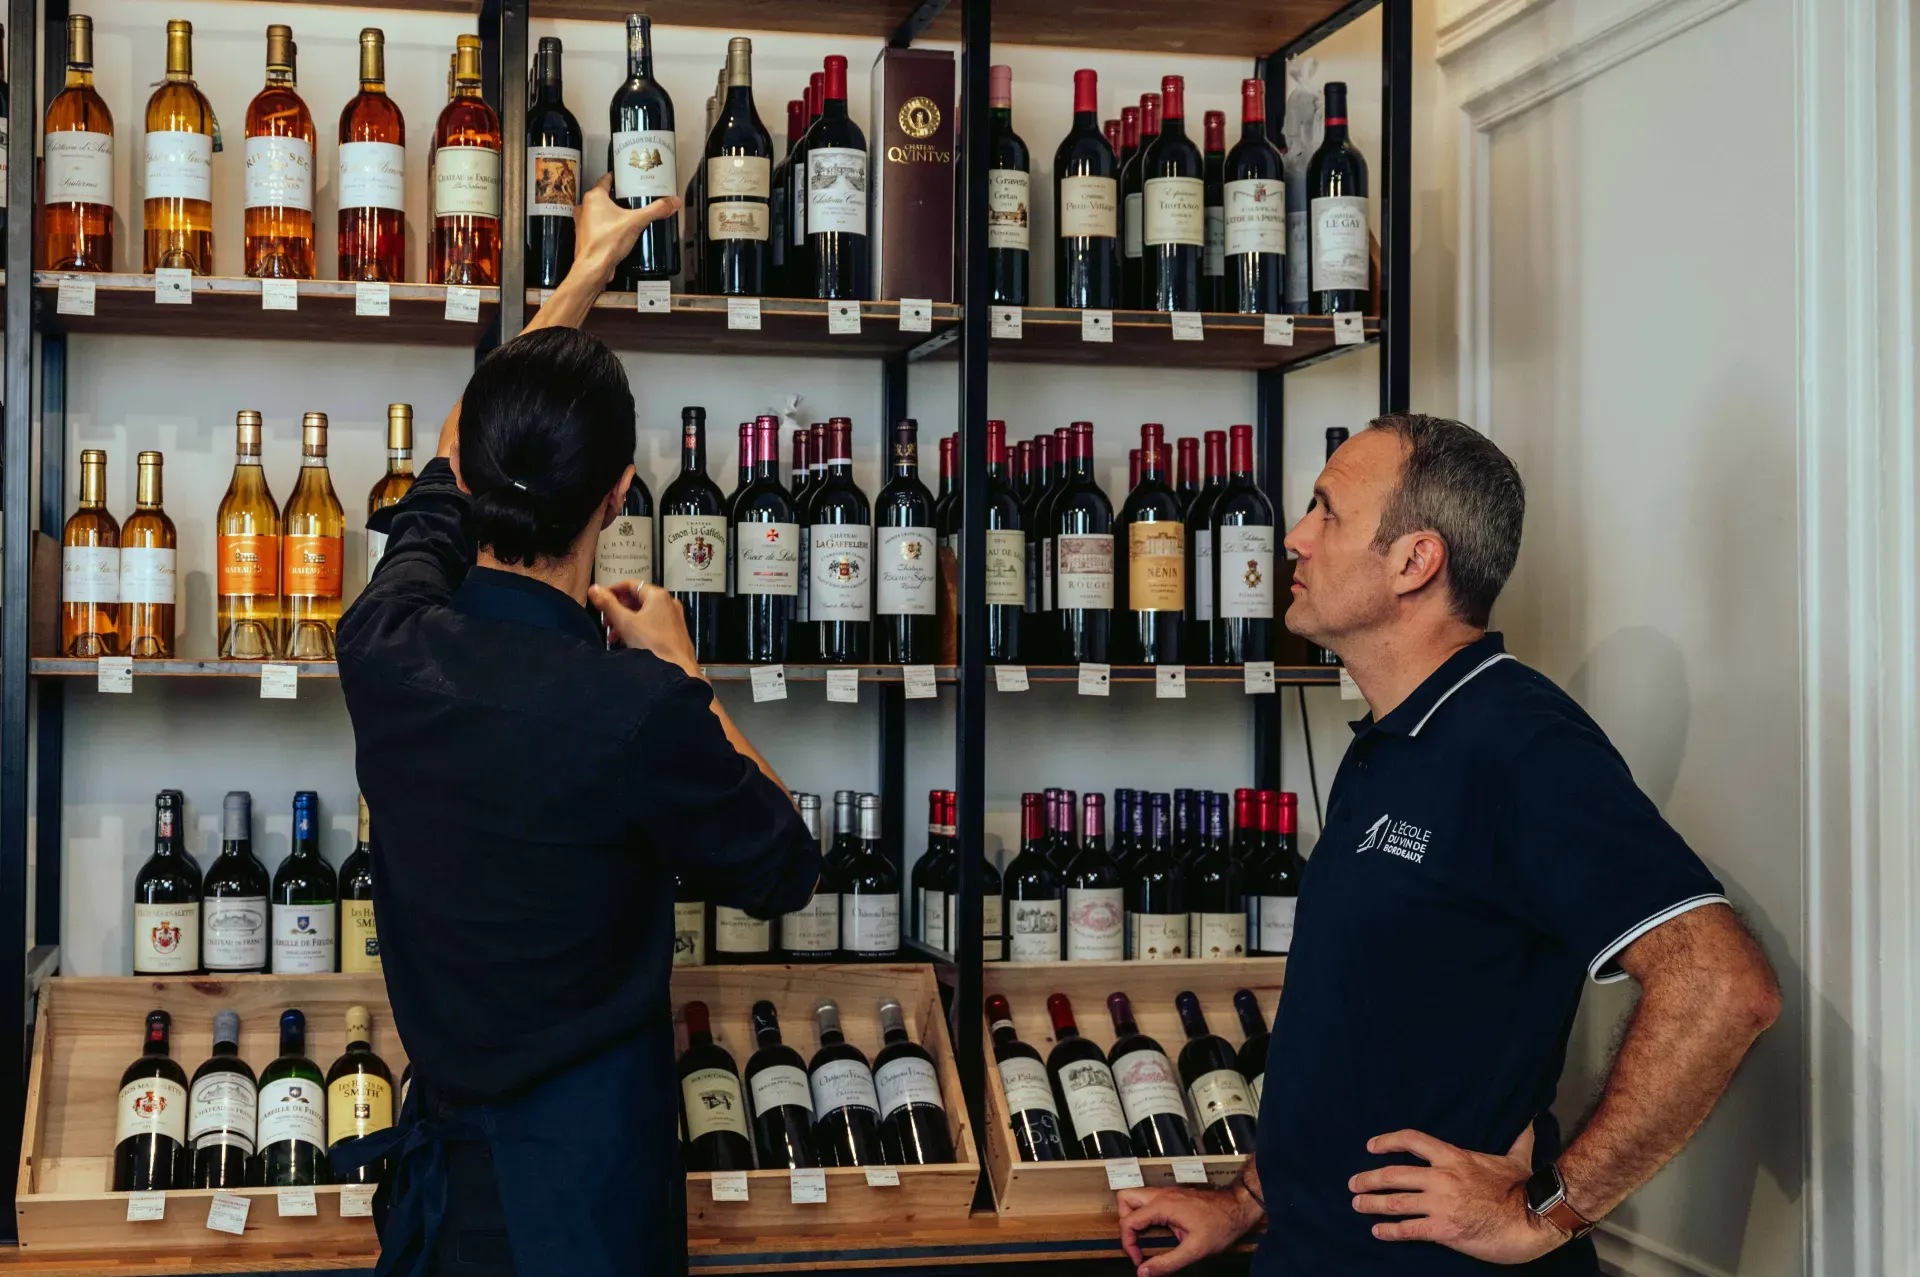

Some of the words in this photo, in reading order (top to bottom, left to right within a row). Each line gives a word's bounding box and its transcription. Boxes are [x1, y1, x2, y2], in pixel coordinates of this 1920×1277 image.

[888, 146, 950, 164] QVINTVS
[994, 192, 1018, 200] Certan
[1326, 220, 1338, 228] LE
[1342, 220, 1360, 228] GAY
[816, 540, 826, 548] LA
[1392, 820, 1432, 842] L'ÉCOLE
[1388, 834, 1400, 844] DU
[1399, 836, 1413, 849] VIN
[1412, 841, 1427, 853] DE
[1383, 844, 1423, 864] BORDEAUX
[1005, 1076, 1016, 1084] Le
[338, 1083, 350, 1092] LES
